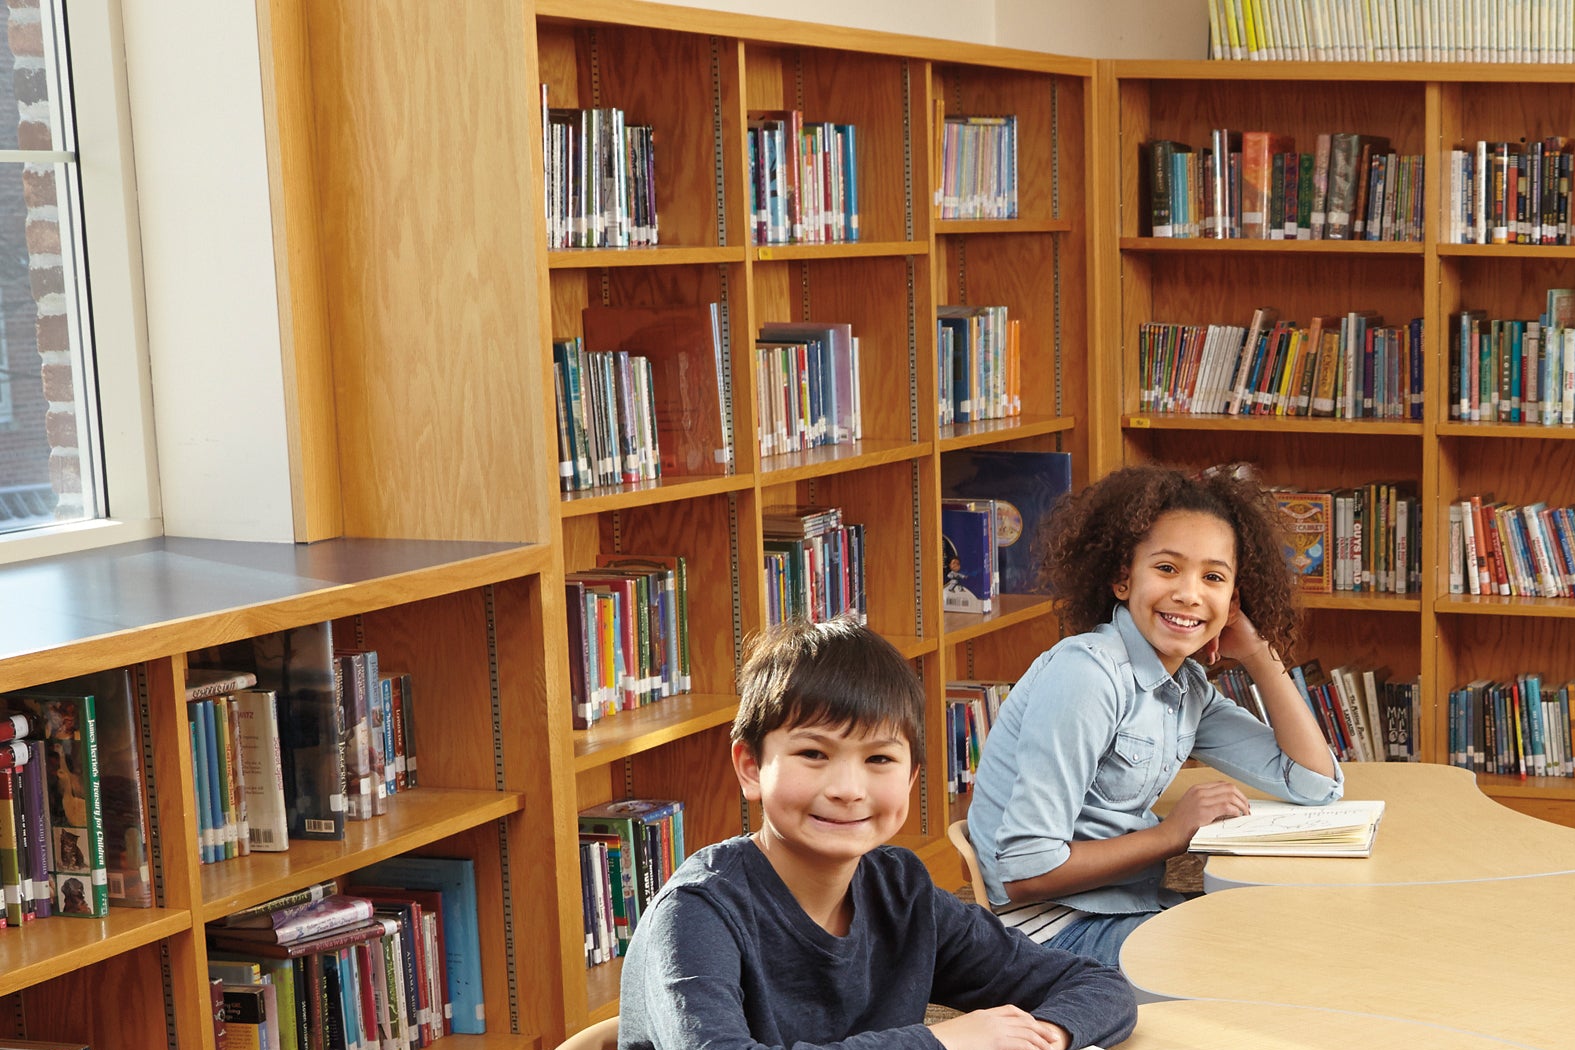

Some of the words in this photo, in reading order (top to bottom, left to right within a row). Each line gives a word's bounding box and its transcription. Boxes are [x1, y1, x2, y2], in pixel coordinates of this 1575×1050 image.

[1353, 523, 1362, 552] GUYS
[88, 719, 97, 743] James
[90, 744, 100, 778] Herriot's
[92, 781, 102, 816] Treasury
[94, 818, 102, 831] for
[96, 831, 105, 866] Children
[316, 936, 349, 950] RUNAWAY
[350, 933, 367, 942] TWIN
[406, 952, 414, 992] ALABAMA
